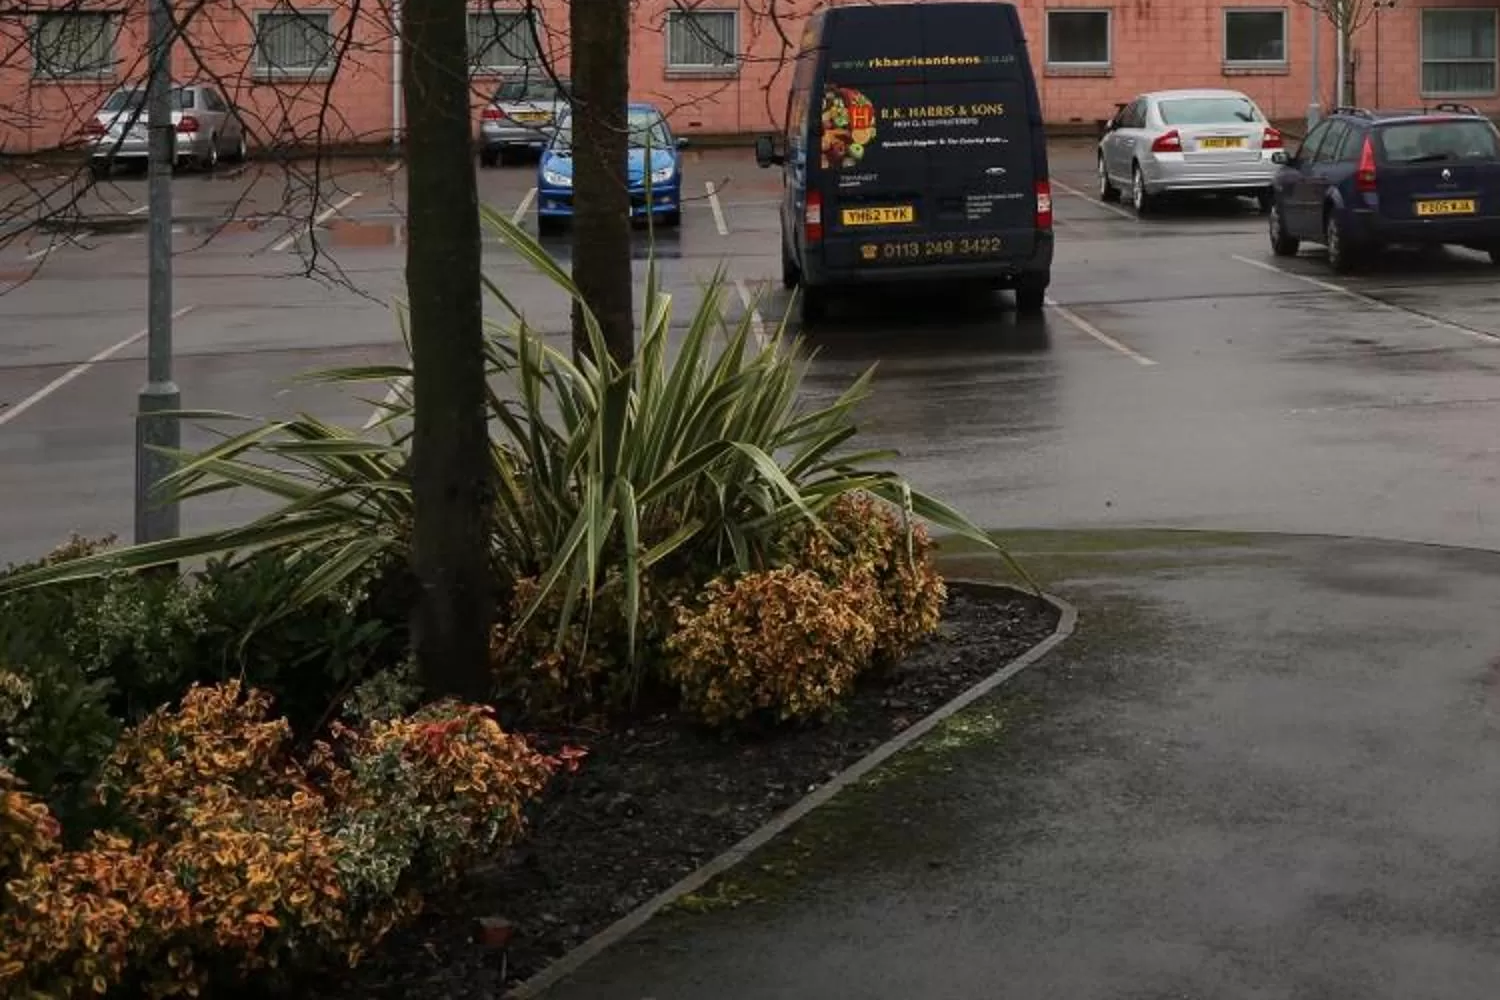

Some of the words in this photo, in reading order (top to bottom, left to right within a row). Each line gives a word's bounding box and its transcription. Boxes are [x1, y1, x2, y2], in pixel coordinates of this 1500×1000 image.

[852, 106, 869, 128] H
[908, 105, 955, 117] HARRIS
[958, 105, 968, 116] &
[971, 103, 1004, 116] SONS
[883, 242, 919, 258] 0113
